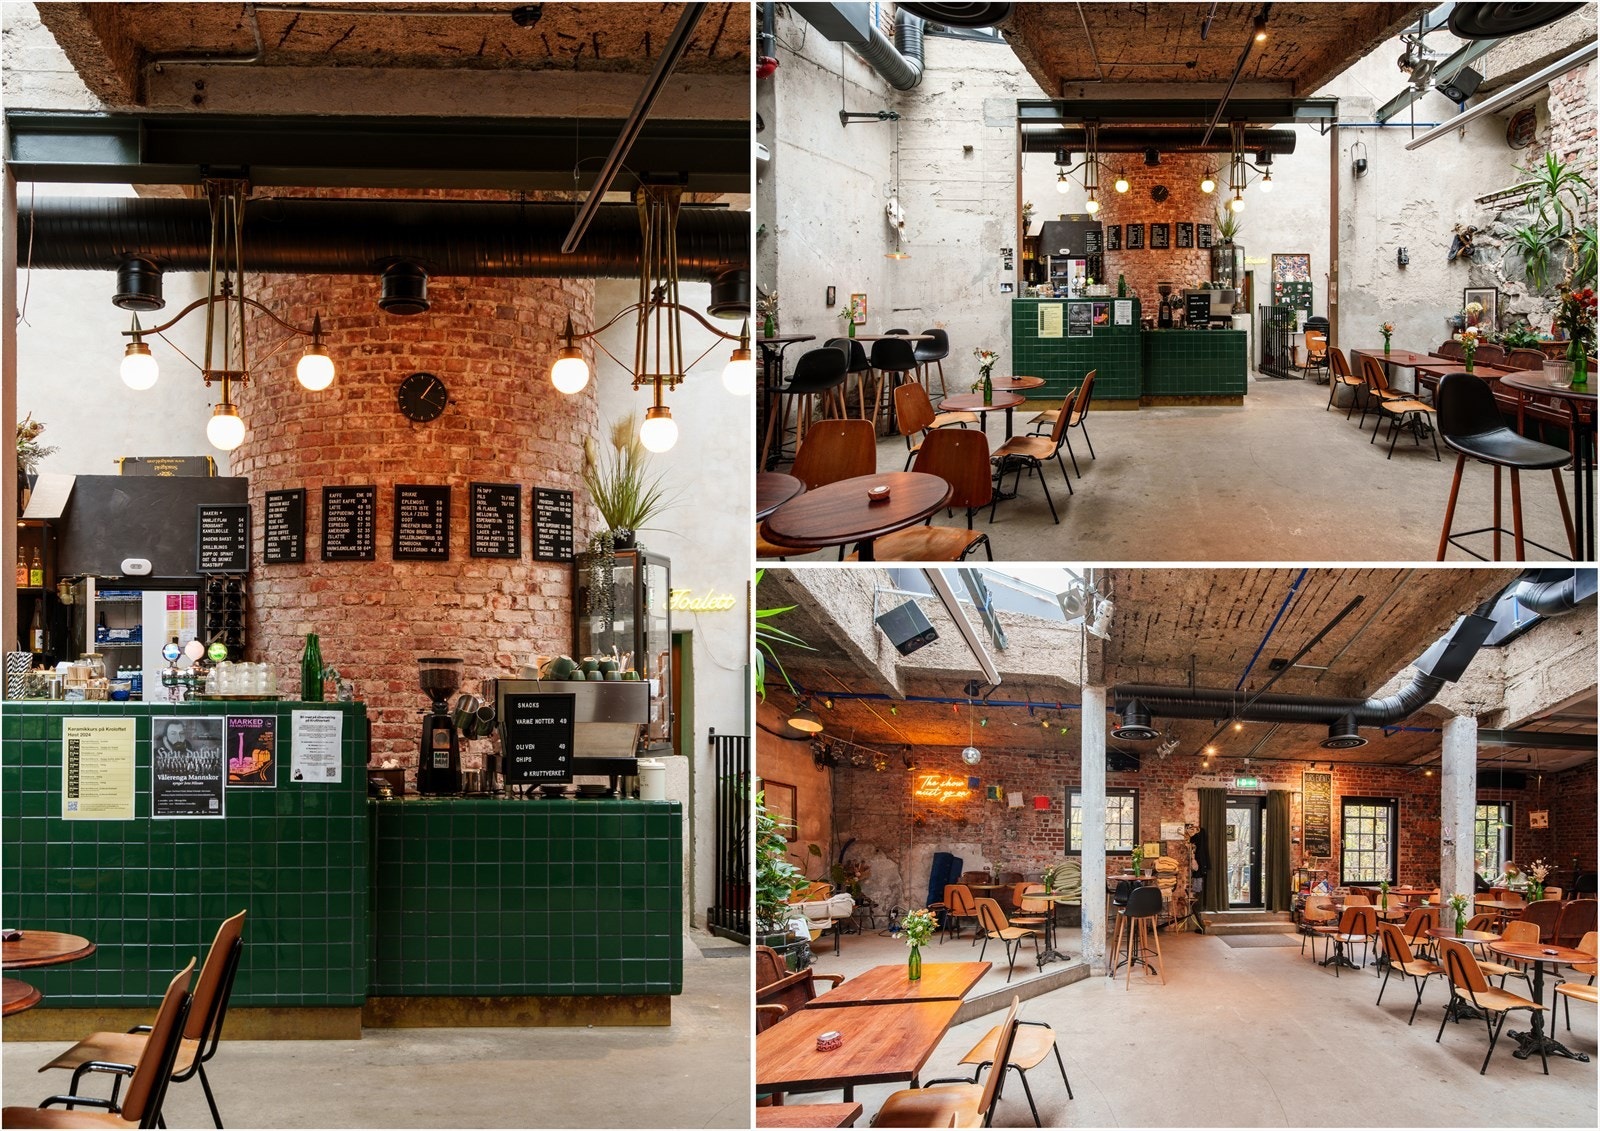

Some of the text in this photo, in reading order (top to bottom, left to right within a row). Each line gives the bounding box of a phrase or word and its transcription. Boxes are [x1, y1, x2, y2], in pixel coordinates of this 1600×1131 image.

[662, 588, 736, 611] Toalett
[919, 775, 965, 789] The show
[915, 786, 942, 797] must
[940, 790, 955, 802] go
